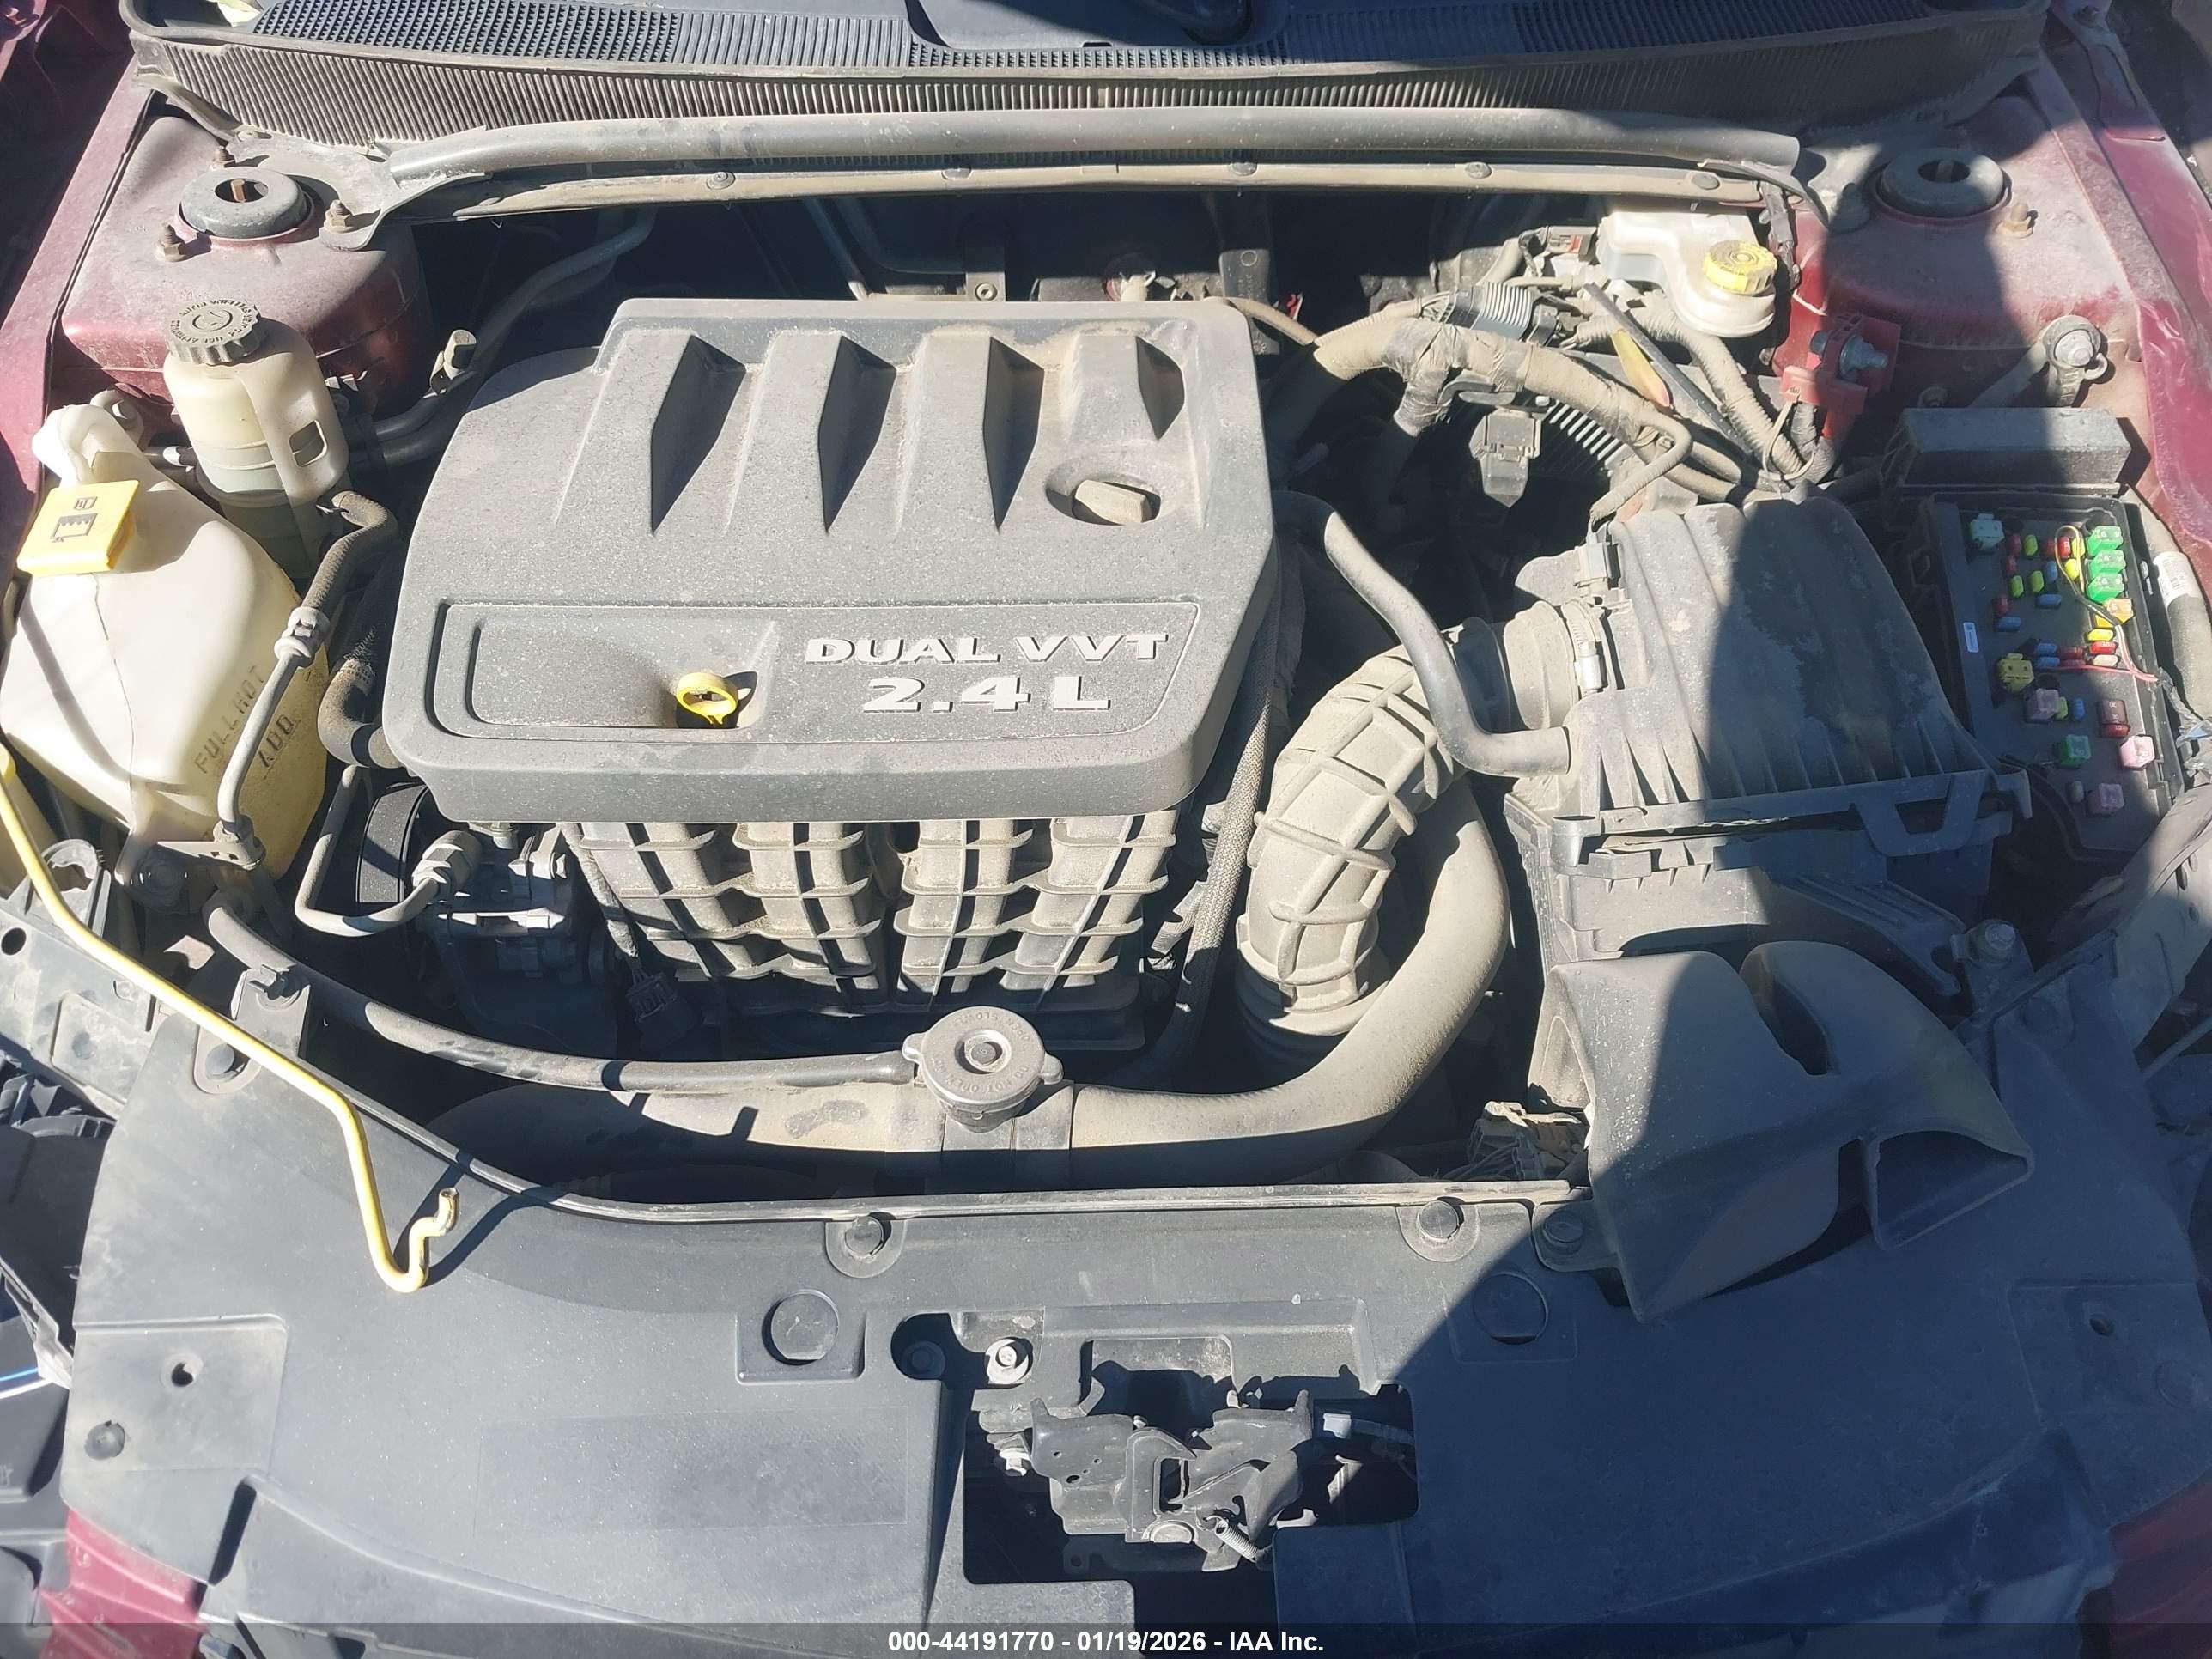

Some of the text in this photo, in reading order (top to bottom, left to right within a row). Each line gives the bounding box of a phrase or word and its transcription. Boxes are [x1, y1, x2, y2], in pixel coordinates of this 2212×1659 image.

[805, 634, 1169, 665] DUAL VVT
[193, 714, 240, 774] FULL
[258, 714, 295, 768] ADD
